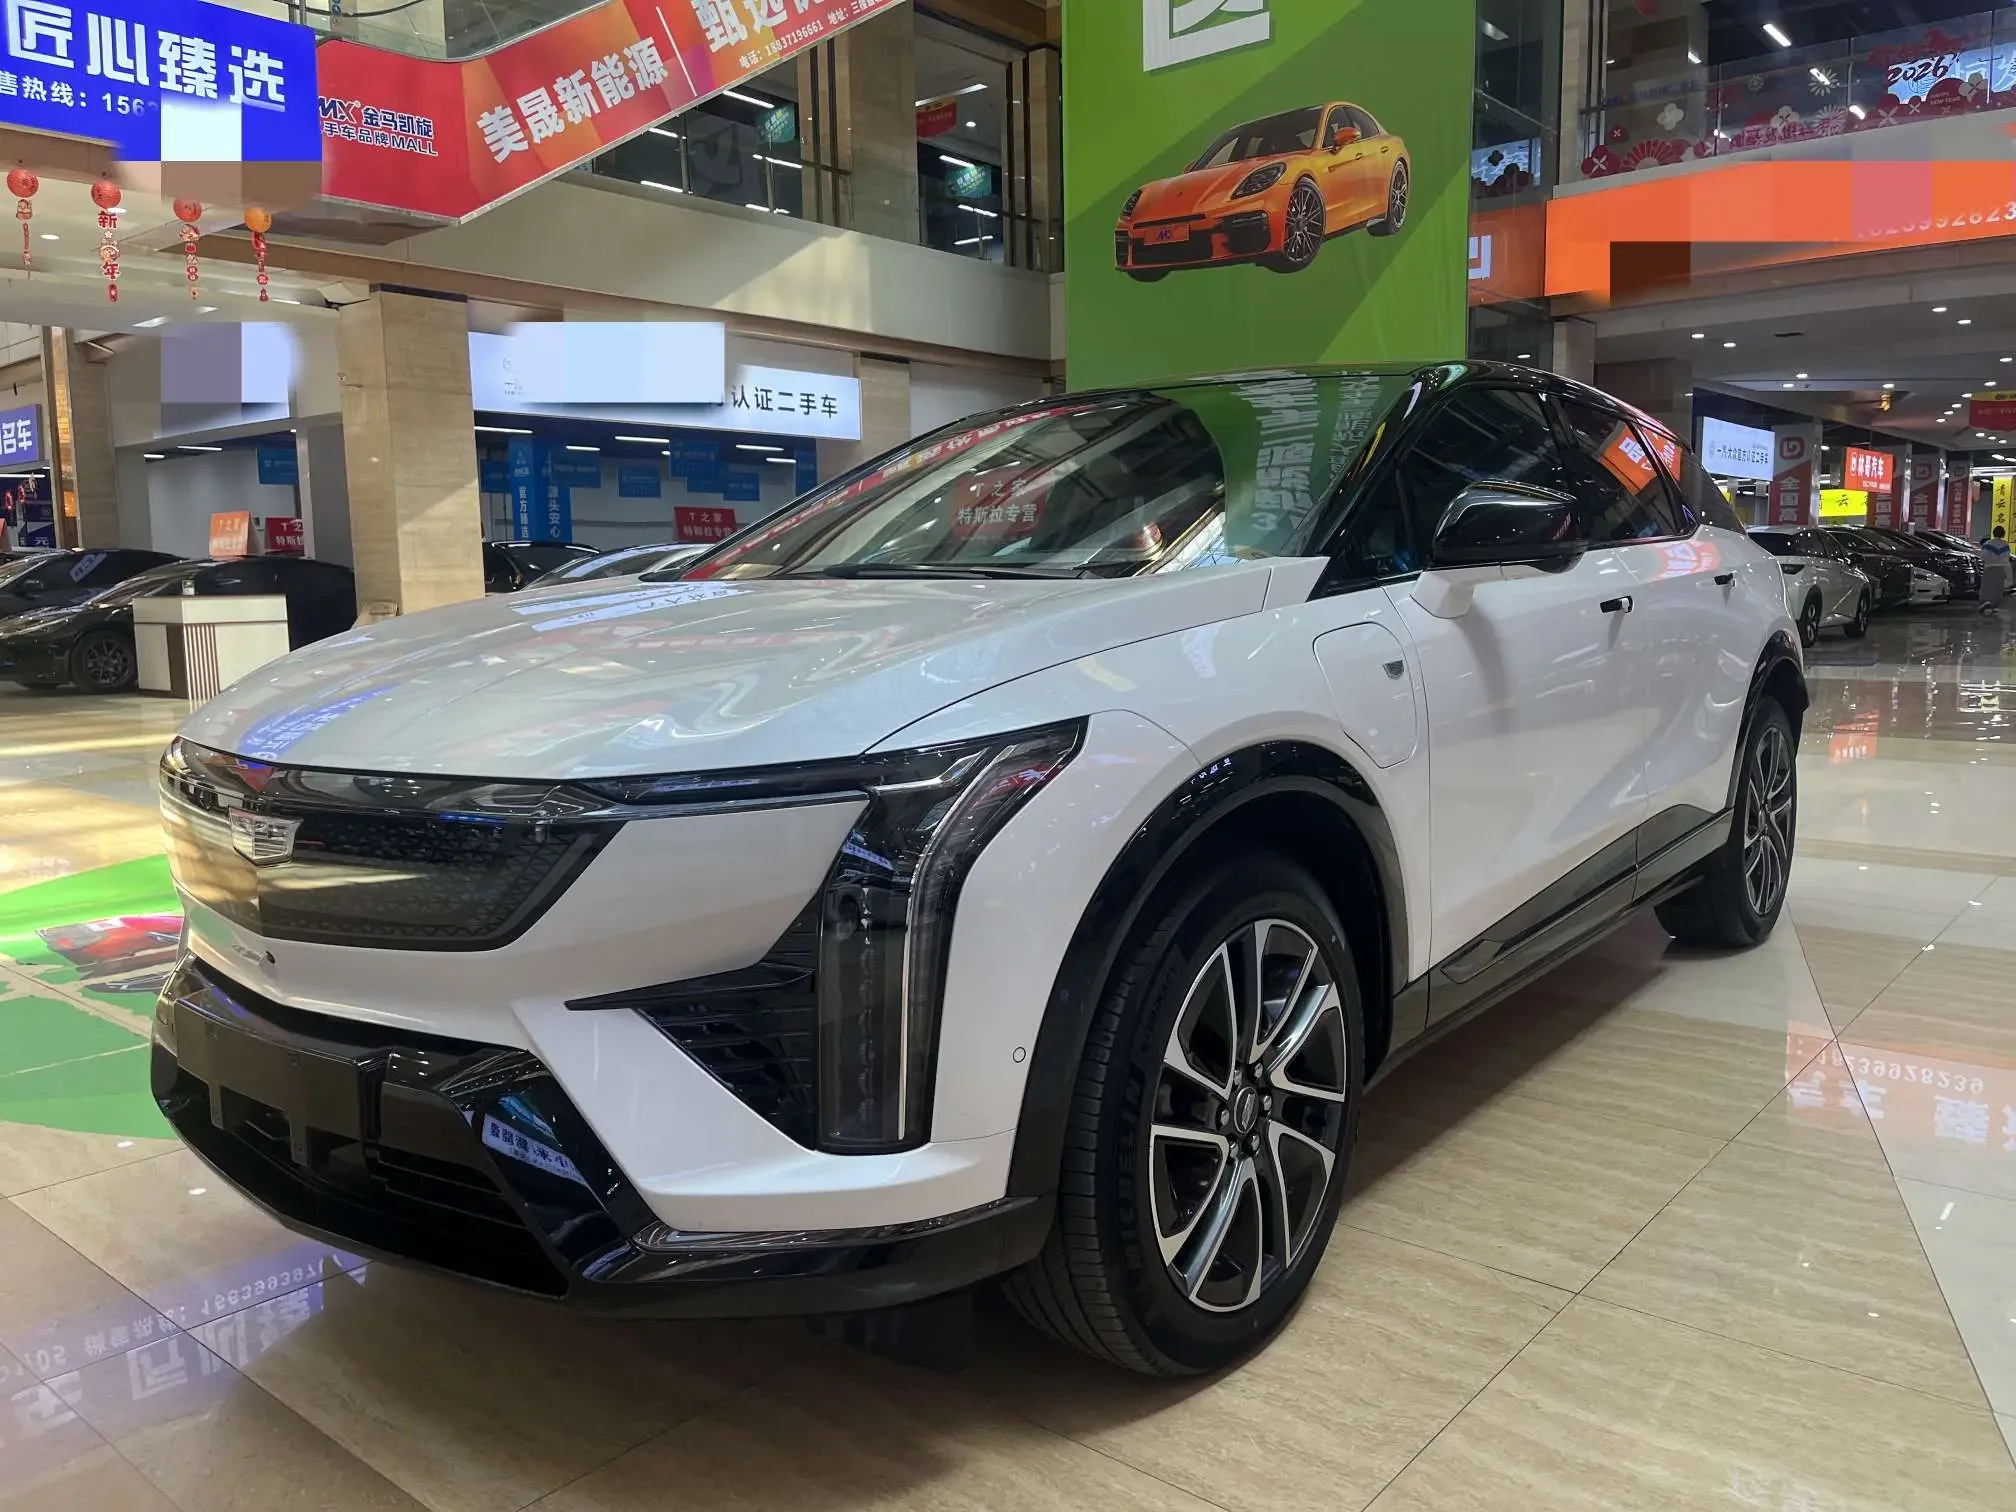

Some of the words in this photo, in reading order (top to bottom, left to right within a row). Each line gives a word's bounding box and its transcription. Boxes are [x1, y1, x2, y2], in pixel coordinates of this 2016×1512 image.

[7, 0, 286, 112] 匠心臻选
[476, 36, 669, 163] 美晟新能源
[319, 121, 438, 156] 手车品牌MALL
[361, 106, 434, 139] 金马凯旋
[958, 503, 1037, 525] 特斯拉专营
